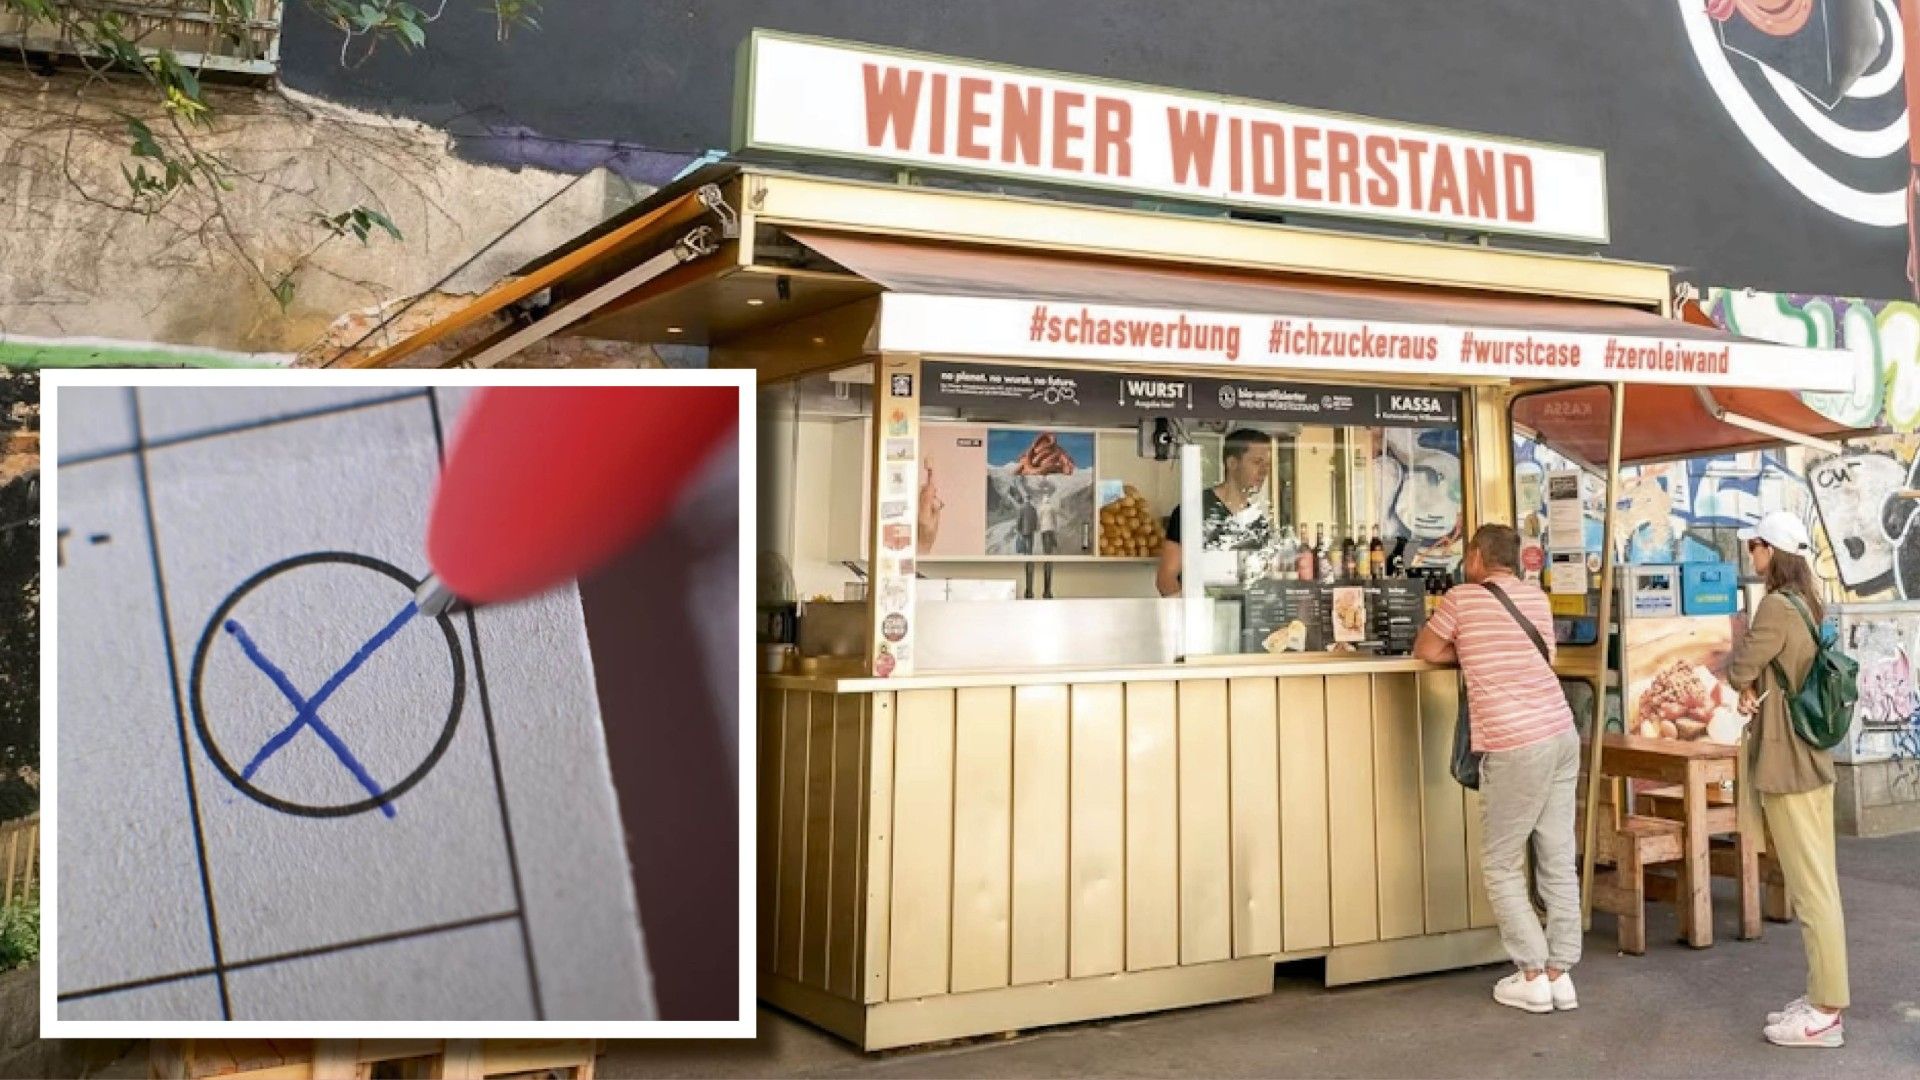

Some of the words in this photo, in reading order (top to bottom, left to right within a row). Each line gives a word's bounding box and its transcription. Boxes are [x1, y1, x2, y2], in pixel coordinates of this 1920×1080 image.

[862, 62, 1133, 177] WIENER
[1166, 106, 1536, 223] WIDERSTAND
[1029, 304, 1242, 362] #schaswerbung
[1268, 319, 1439, 361] #ichzuckeraus
[1460, 331, 1581, 368] #wurstcase
[1605, 337, 1730, 375] #zeroleiwand
[1127, 380, 1185, 399] WURST
[1390, 394, 1441, 413] KASSA
